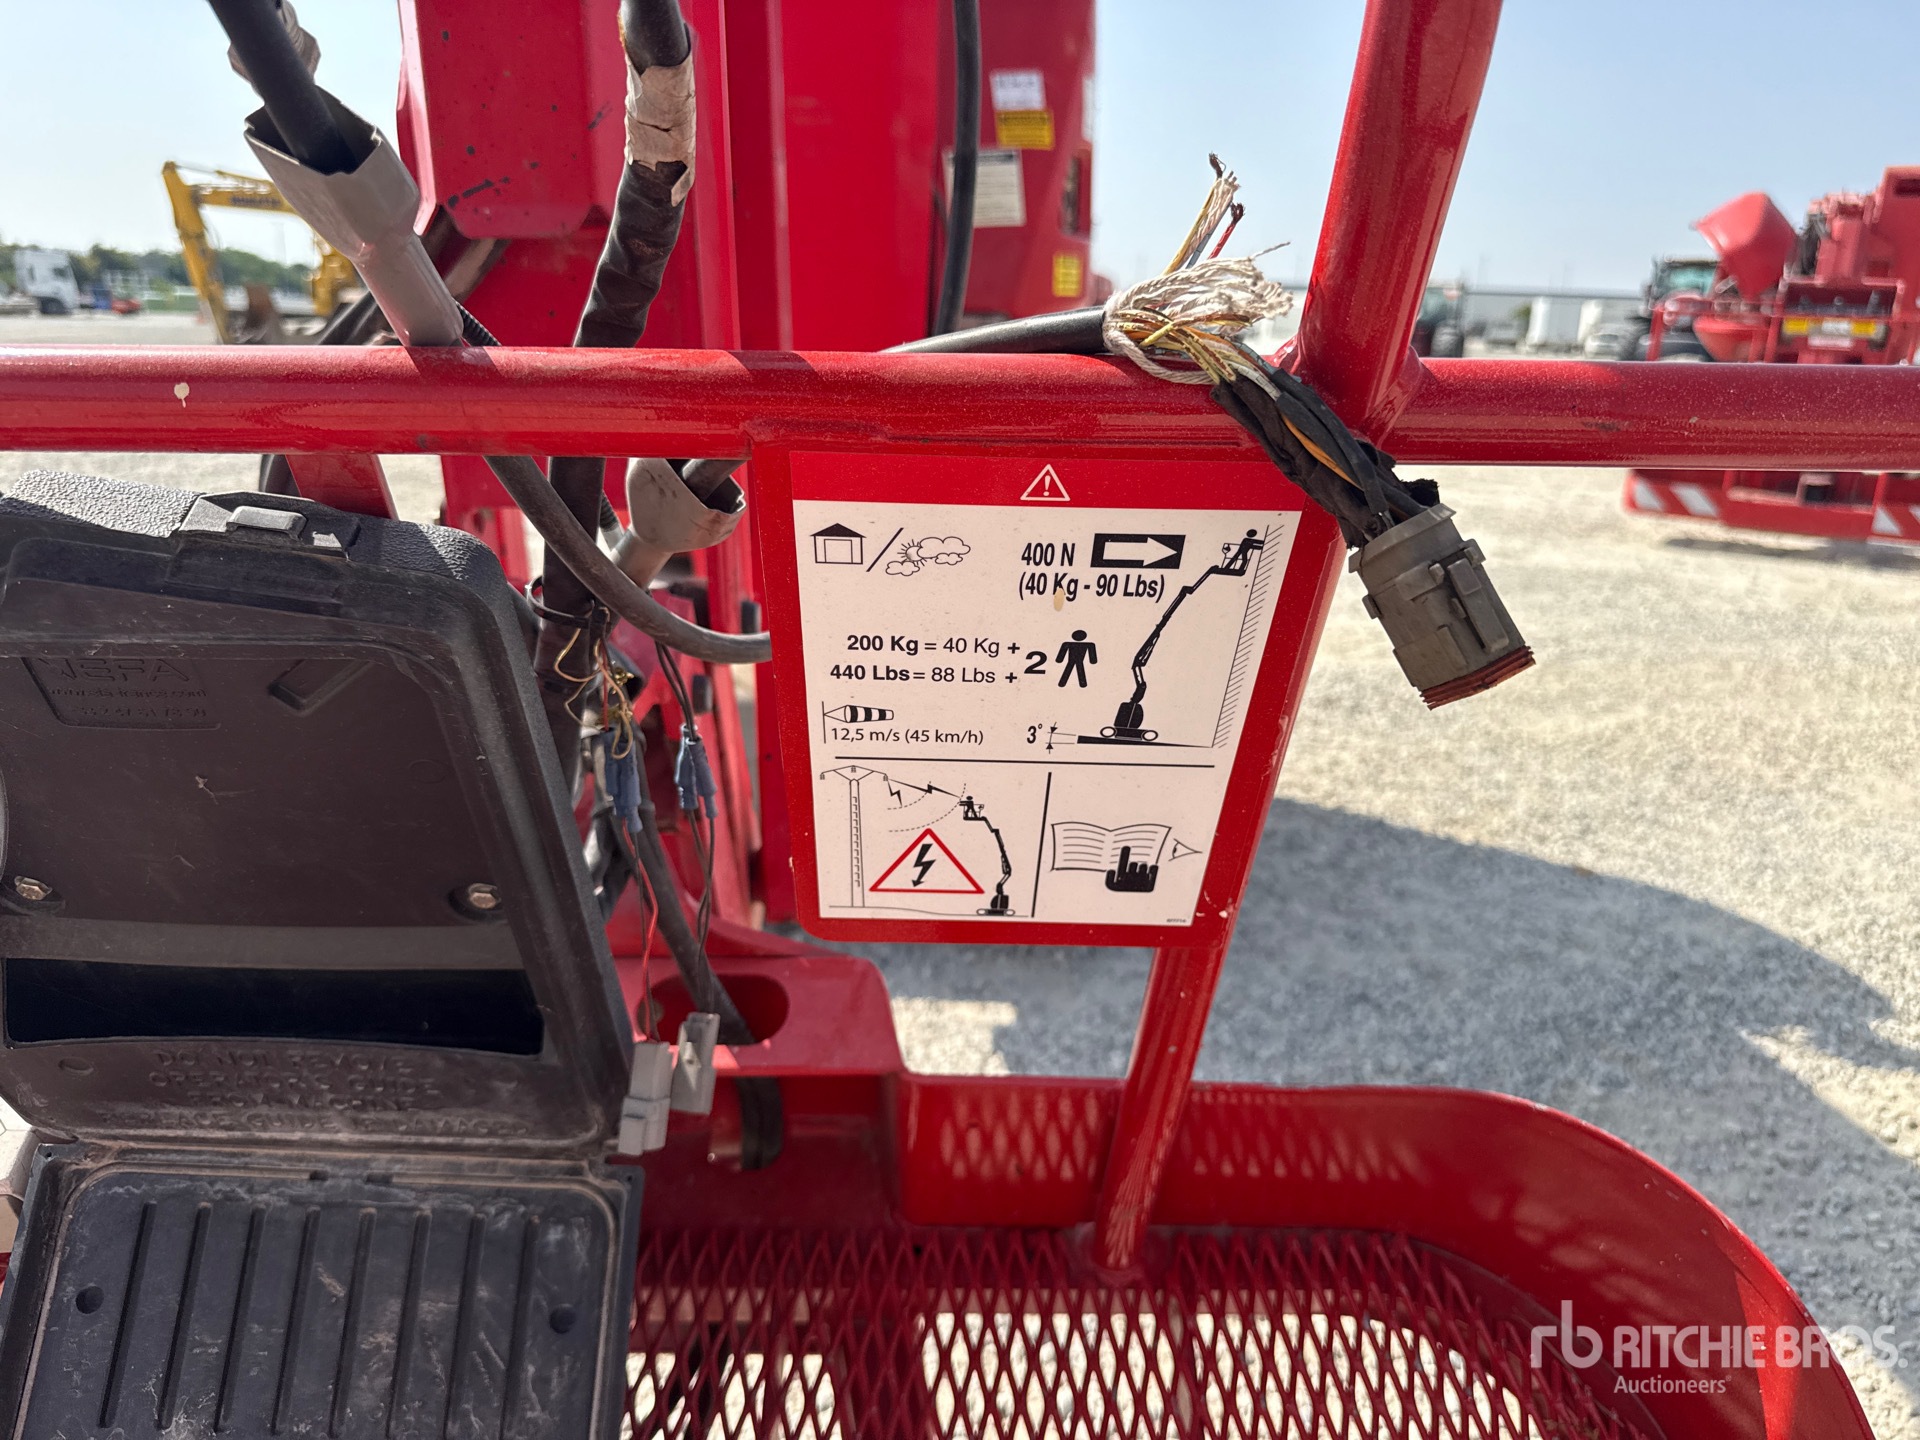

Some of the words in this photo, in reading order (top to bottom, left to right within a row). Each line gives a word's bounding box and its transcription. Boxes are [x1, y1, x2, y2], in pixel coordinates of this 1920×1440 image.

[1021, 543, 1055, 566] 400
[1060, 543, 1075, 566] N
[1019, 572, 1047, 600] (40
[1053, 573, 1078, 602] Kg
[1096, 574, 1118, 597] 90
[1123, 574, 1165, 603] Lbs)
[847, 635, 883, 651] 200
[890, 636, 919, 656] Kg
[943, 638, 967, 653] 40
[974, 638, 1000, 658] Kg
[830, 665, 866, 680] 440
[931, 667, 955, 682] 88
[961, 668, 996, 683] Lbs
[1024, 651, 1048, 675] 2
[831, 727, 864, 743] 12,5
[869, 728, 900, 742] m/s
[905, 729, 930, 744] (45
[935, 729, 984, 745] km/h)
